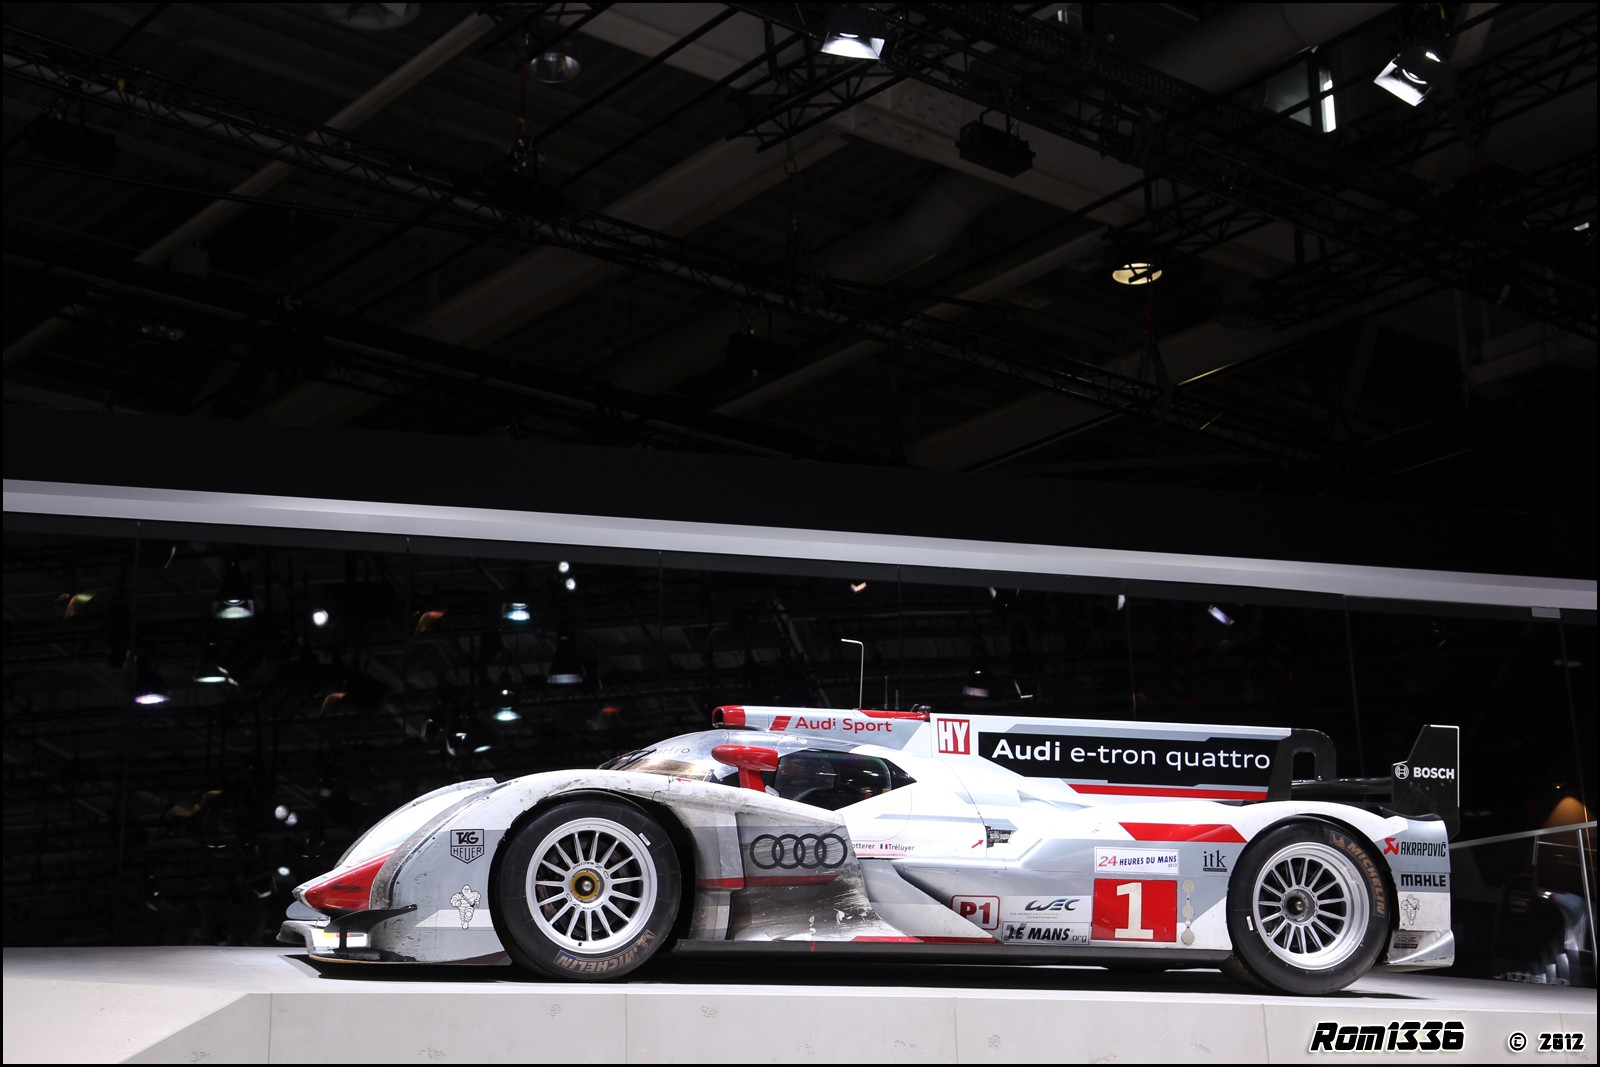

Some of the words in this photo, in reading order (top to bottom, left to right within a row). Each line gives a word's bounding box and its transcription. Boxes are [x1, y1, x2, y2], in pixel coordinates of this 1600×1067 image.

[795, 717, 836, 730] Audi
[842, 718, 893, 734] Sport
[938, 719, 970, 753] HY
[991, 739, 1061, 762] Audi
[1070, 744, 1156, 765] e-tron
[1166, 749, 1271, 771] quattro
[1413, 766, 1455, 780] BOSCH
[455, 831, 479, 845] TAG
[452, 846, 482, 861] HEUER
[888, 843, 916, 852] Tréluyer
[1400, 841, 1447, 858] AKRAPOVIČ
[1098, 855, 1118, 867] 24
[1119, 857, 1145, 867] HEURES
[1146, 856, 1156, 865] DU
[1157, 854, 1178, 864] MANS
[1203, 849, 1227, 868] itk
[1347, 841, 1386, 916] MICHELIN
[1400, 873, 1447, 887] MAHLE
[959, 901, 992, 925] P1
[1025, 898, 1081, 911] WEC
[1114, 881, 1154, 940] 1
[1007, 926, 1025, 940] LE
[1027, 927, 1071, 941] MANS
[557, 946, 639, 972] MICHELIN
